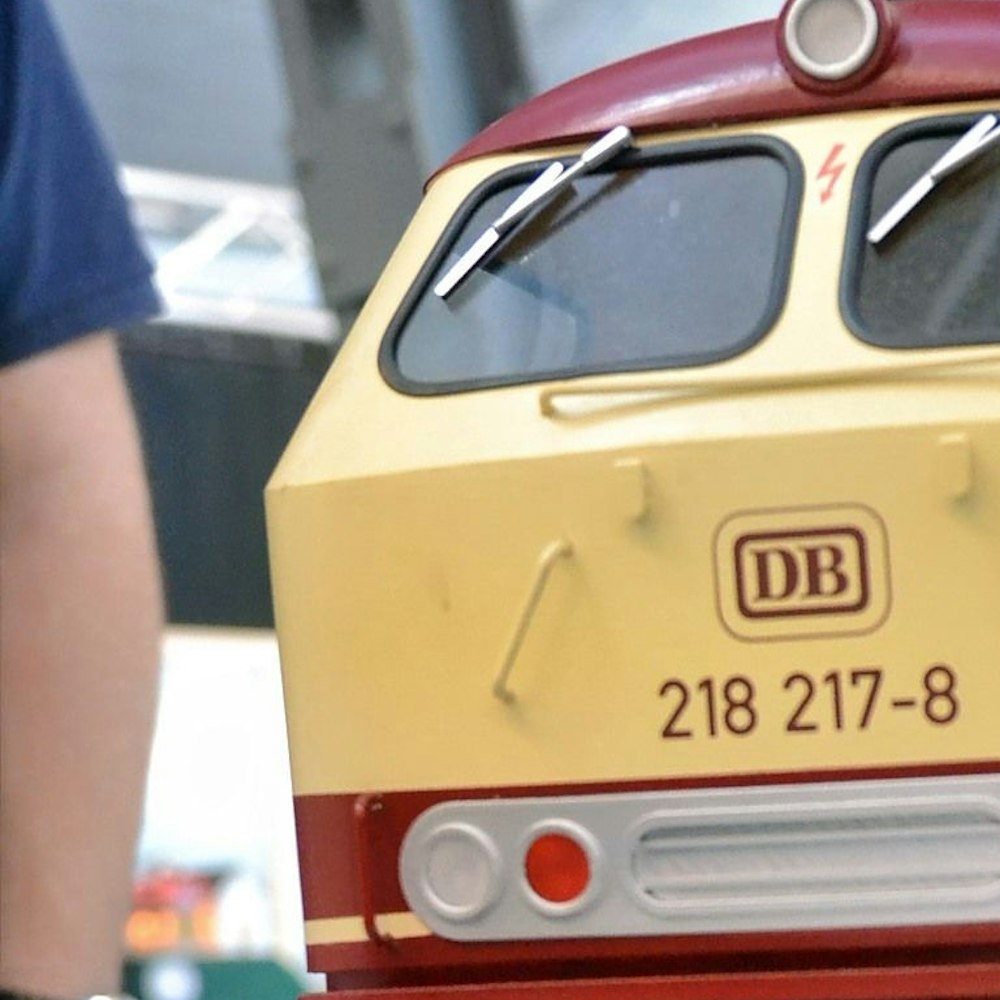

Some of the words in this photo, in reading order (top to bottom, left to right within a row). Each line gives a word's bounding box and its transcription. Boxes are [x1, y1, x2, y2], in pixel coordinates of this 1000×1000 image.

[751, 543, 850, 602] DB
[658, 675, 758, 740] 218
[783, 665, 960, 733] 217-8
